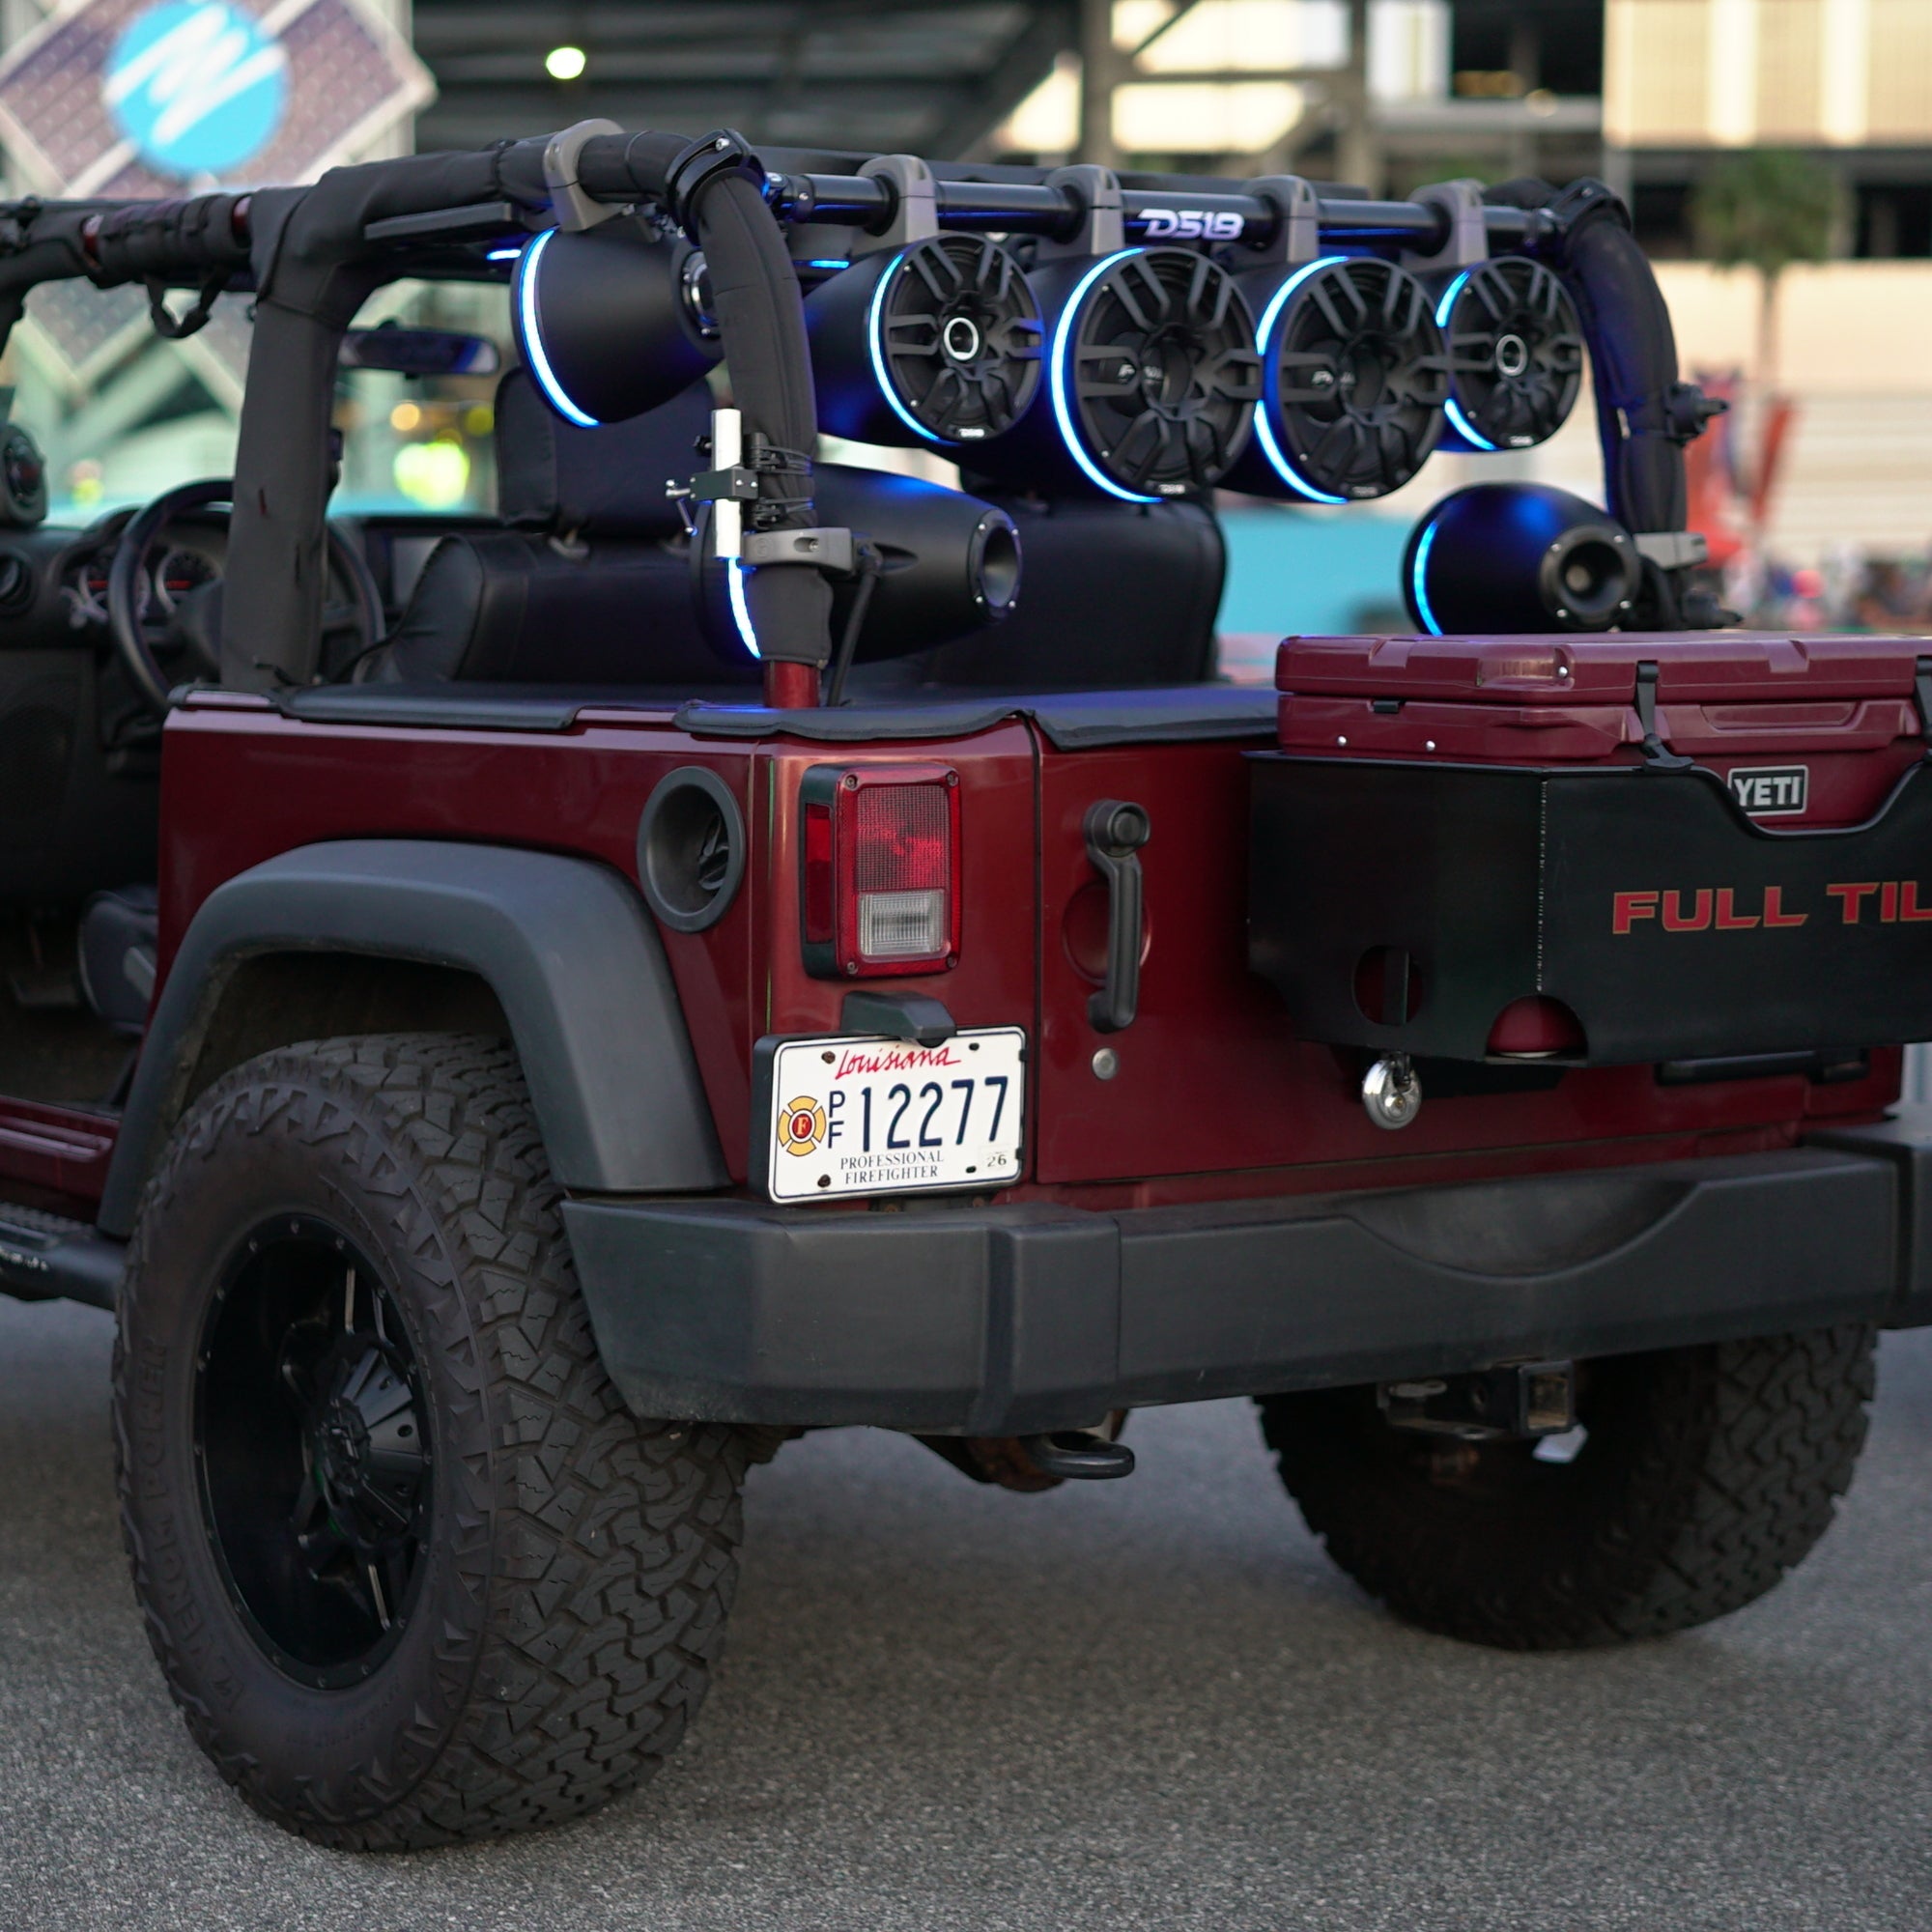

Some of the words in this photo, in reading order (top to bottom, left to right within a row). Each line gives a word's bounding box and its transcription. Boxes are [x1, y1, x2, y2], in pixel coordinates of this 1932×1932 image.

[1137, 209, 1244, 240] DS18
[1733, 777, 1801, 807] YETI
[1612, 885, 1808, 934] FULL
[835, 1046, 962, 1080] Louisiana
[861, 1075, 1009, 1152] 12277
[840, 1151, 944, 1170] PROFESSIONAL
[845, 1166, 939, 1184] FIREFIGHTER
[987, 1153, 1007, 1167] 26
